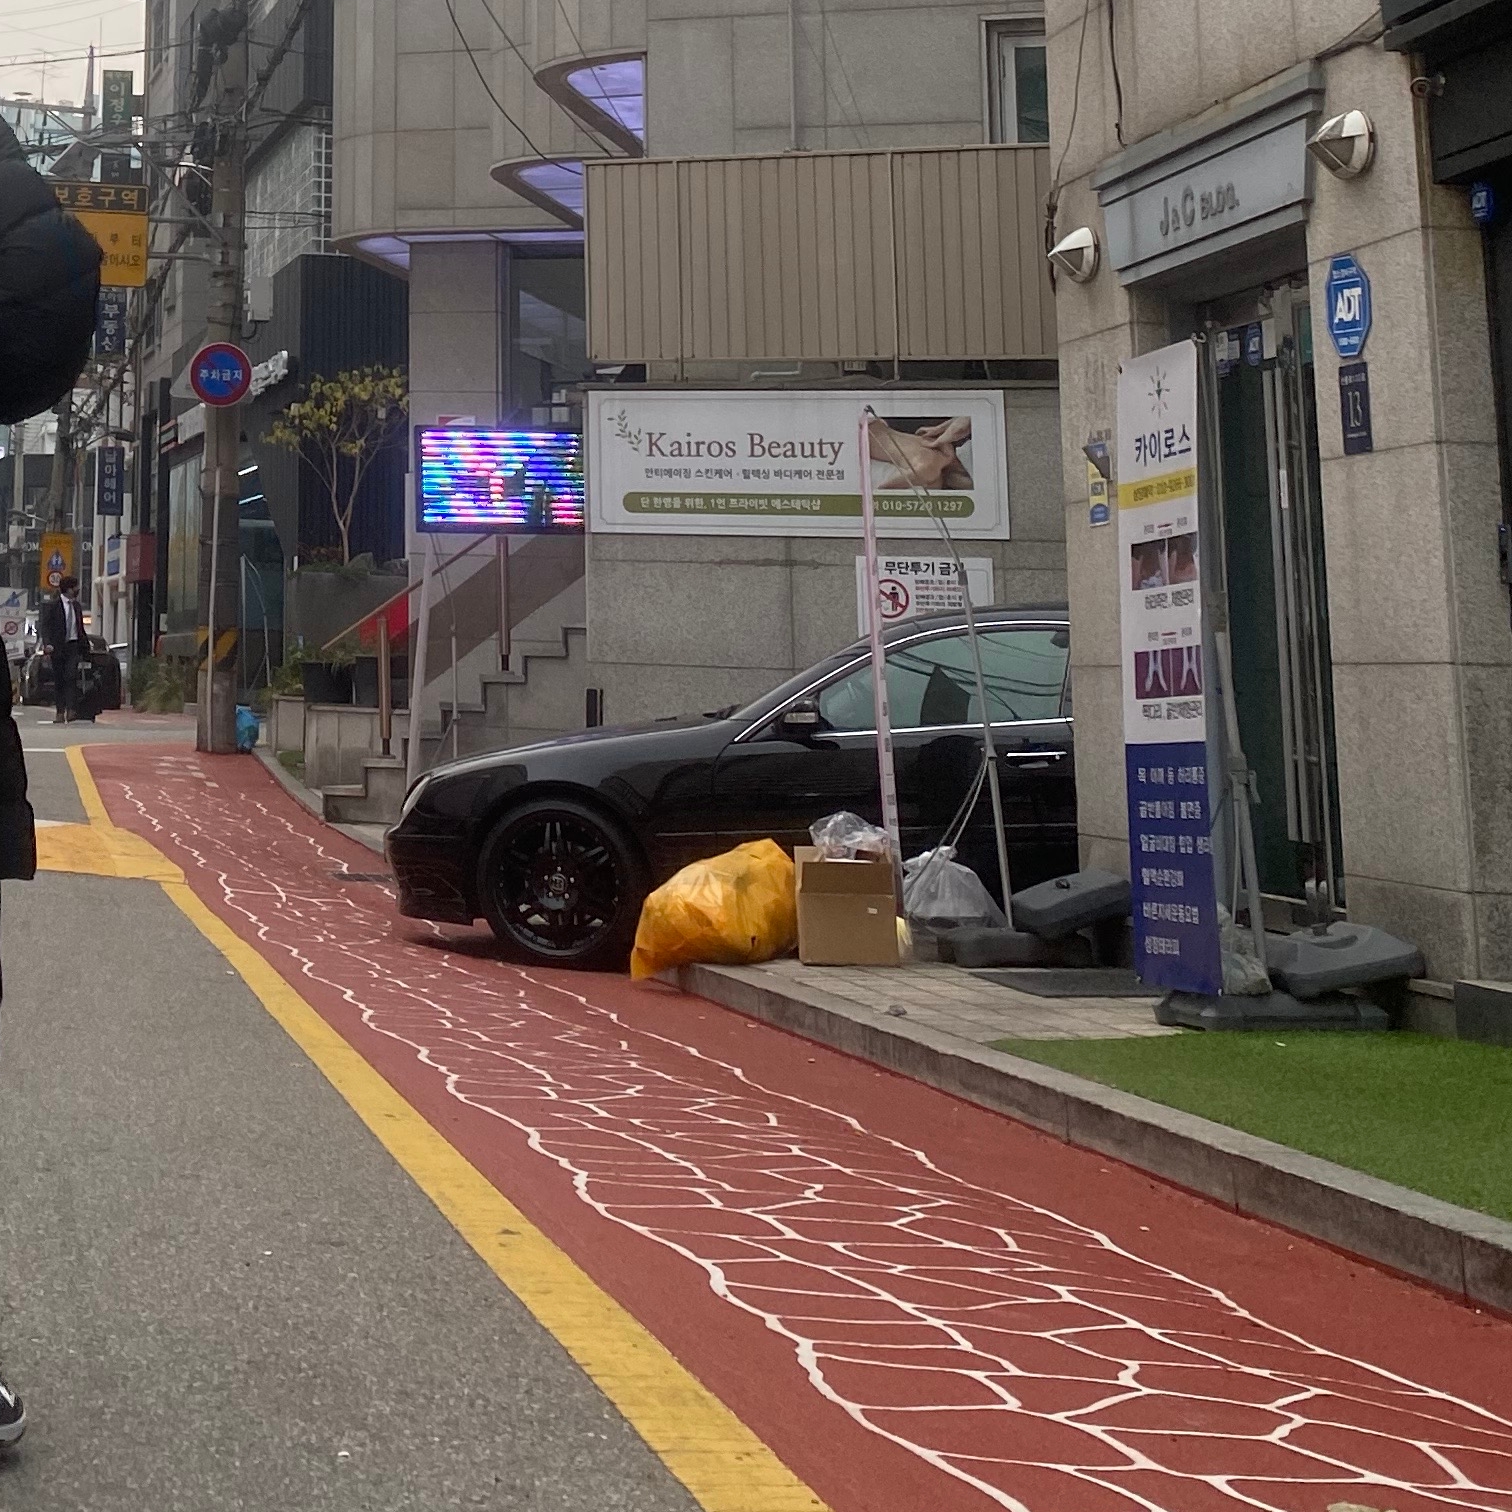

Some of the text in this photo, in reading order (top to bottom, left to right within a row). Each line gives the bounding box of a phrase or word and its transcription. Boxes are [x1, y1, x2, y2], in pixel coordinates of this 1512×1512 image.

[55, 186, 139, 209] 보호구역
[1334, 287, 1363, 324] ADT
[200, 368, 243, 382] 주차금지
[1347, 391, 1363, 428] 13
[645, 431, 844, 465] Kairos Beauty
[1135, 423, 1192, 467] 카이로스
[644, 467, 692, 480] 안티에이징
[694, 468, 733, 480] 스킨케어
[773, 469, 813, 481] 바디케어
[816, 469, 845, 481] 전문점
[884, 561, 935, 576] 무단투기
